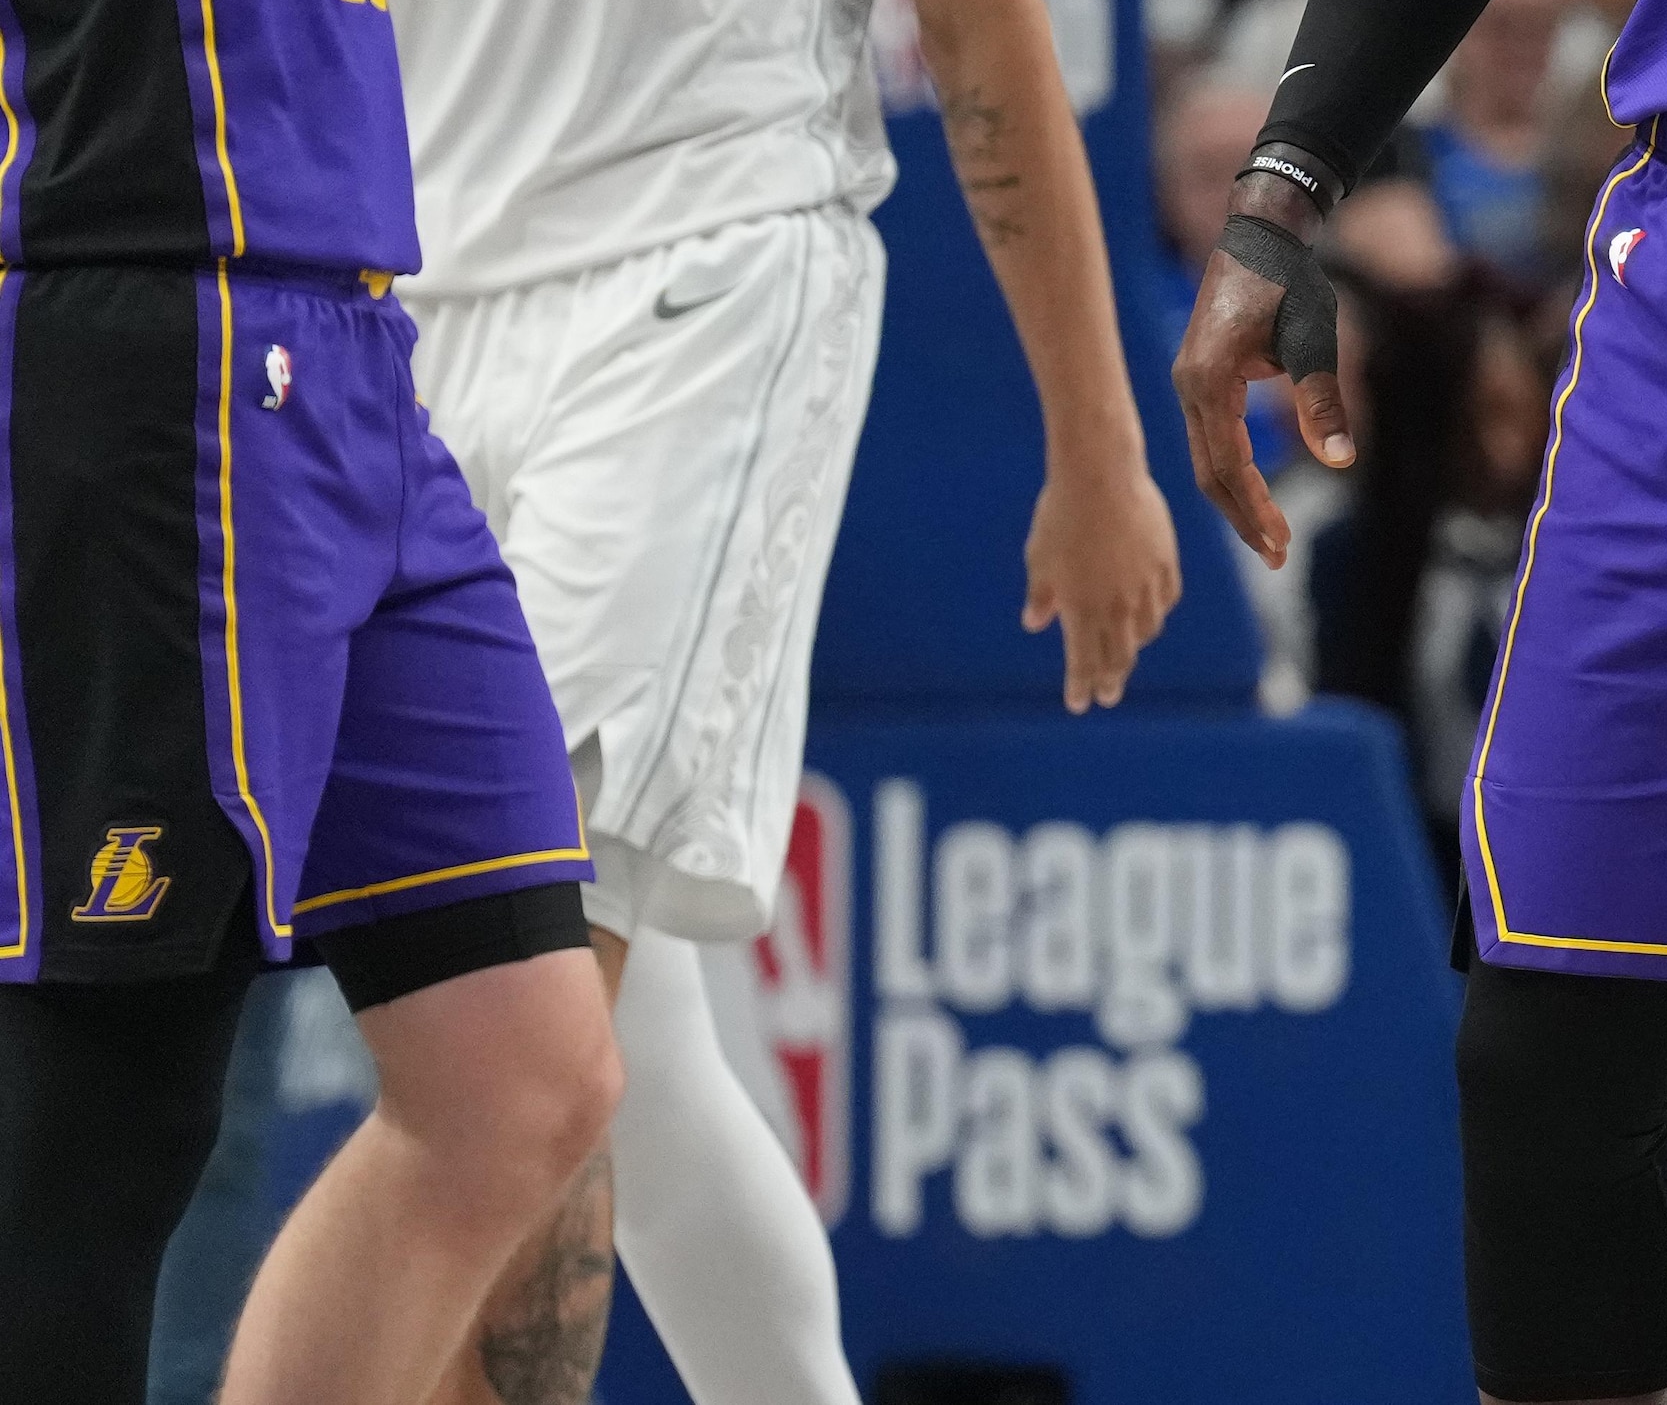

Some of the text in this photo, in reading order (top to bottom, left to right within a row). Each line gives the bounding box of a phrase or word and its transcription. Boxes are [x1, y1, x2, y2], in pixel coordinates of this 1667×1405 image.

[1252, 156, 1313, 188] PROMISE
[872, 775, 1354, 1052] League
[872, 1008, 1207, 1240] Pass
